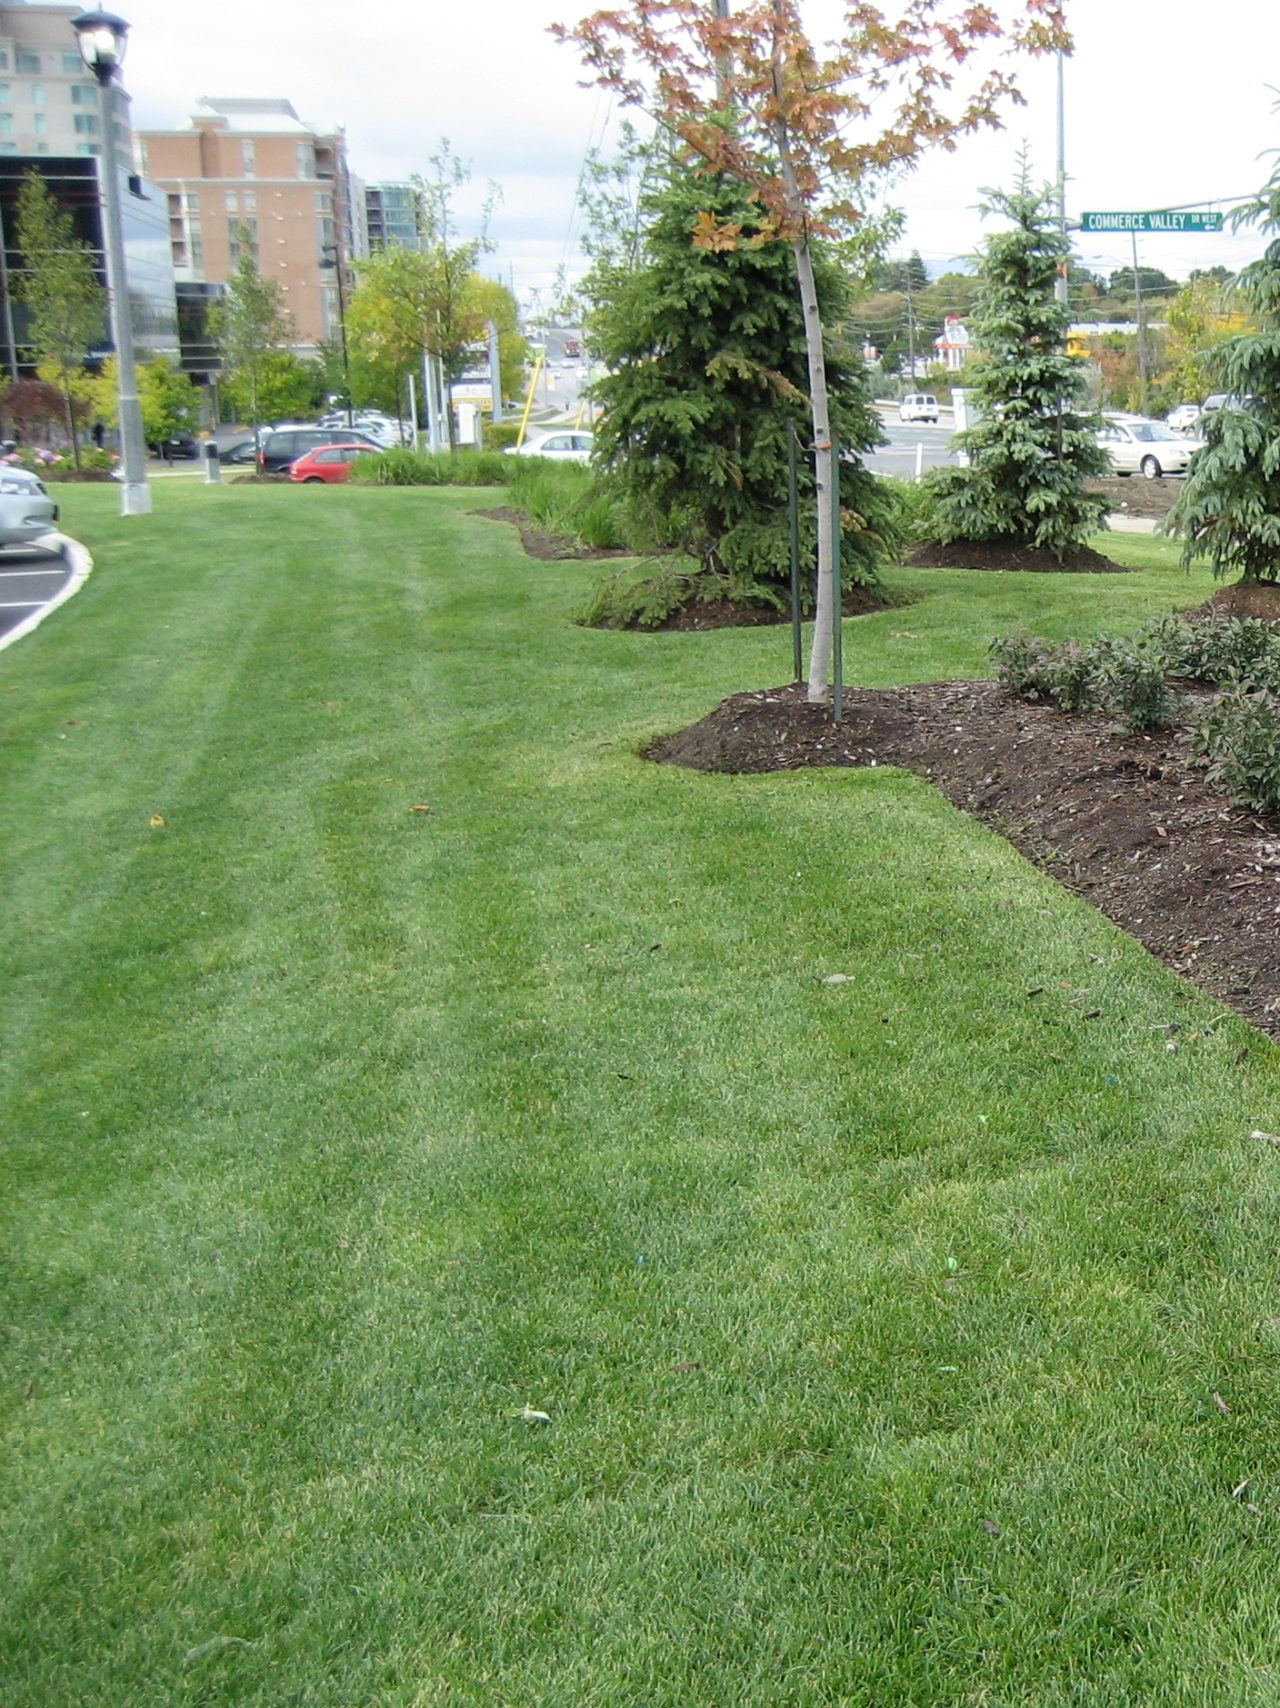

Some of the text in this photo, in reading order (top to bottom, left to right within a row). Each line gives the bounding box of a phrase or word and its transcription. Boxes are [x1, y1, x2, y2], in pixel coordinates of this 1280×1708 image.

[1088, 214, 1217, 229] COMMERCE VALLEY DR WEST
